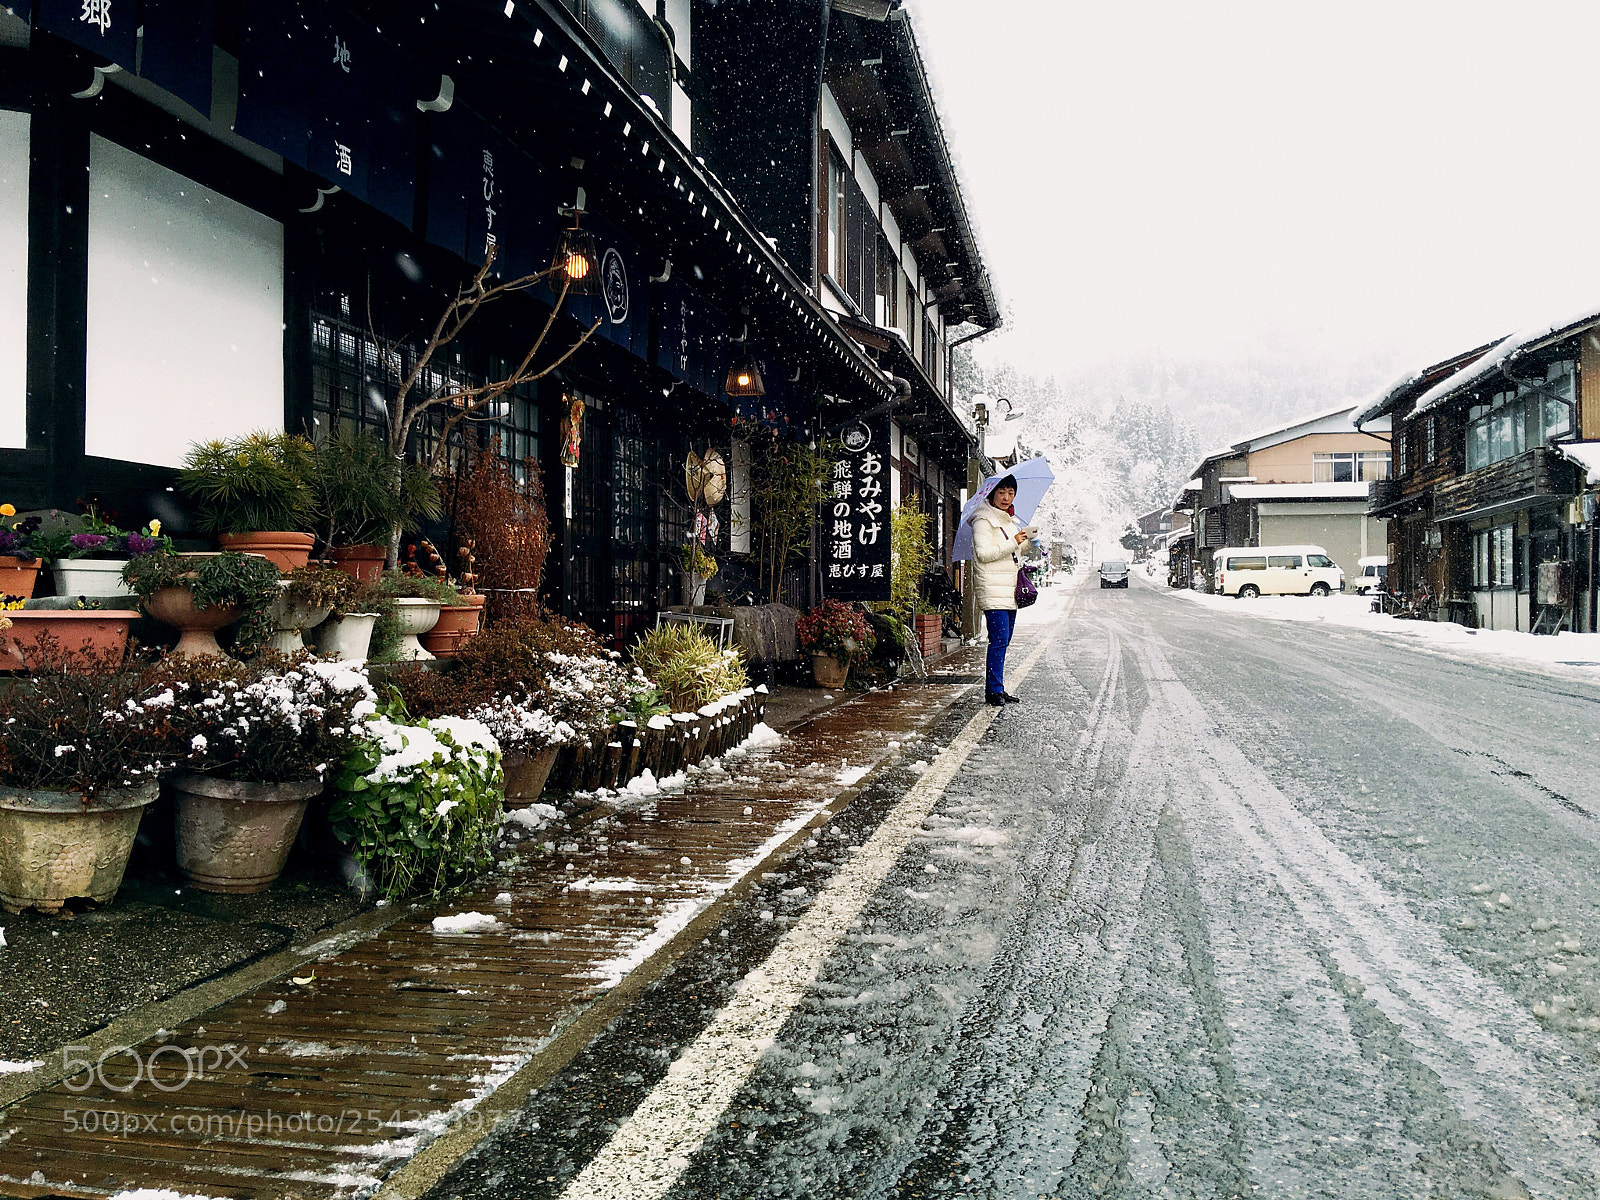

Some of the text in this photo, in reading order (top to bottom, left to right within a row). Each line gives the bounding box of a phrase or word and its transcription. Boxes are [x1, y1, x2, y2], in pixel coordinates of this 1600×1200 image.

[859, 451, 882, 545] おみやげ
[828, 563, 884, 578] 恵びす屋
